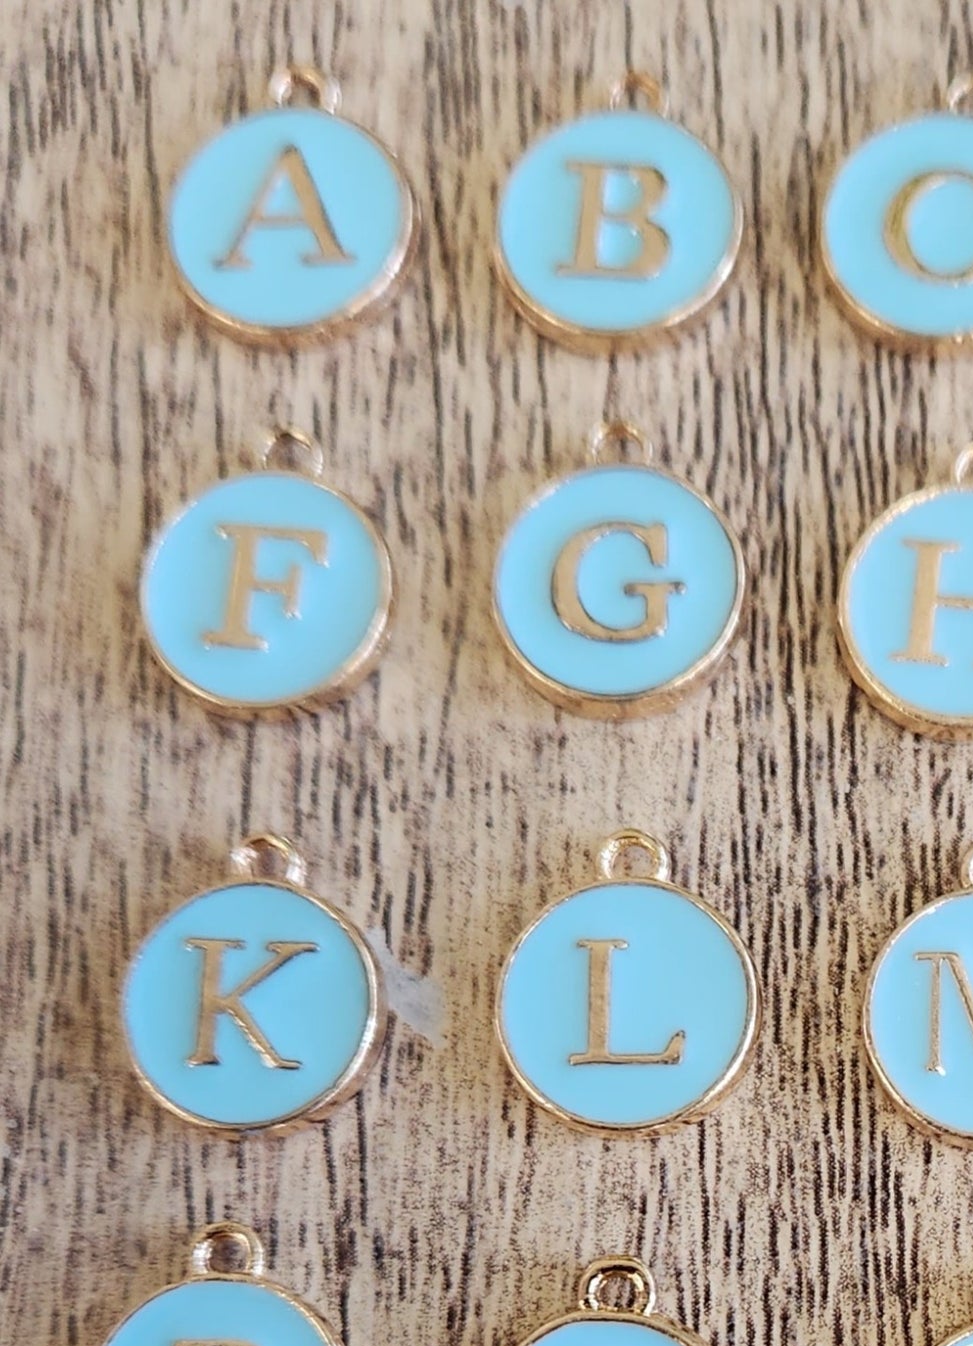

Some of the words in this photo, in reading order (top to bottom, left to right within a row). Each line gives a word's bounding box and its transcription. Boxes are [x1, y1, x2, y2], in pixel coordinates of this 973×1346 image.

[213, 144, 354, 271] A
[555, 163, 670, 280] B
[202, 524, 328, 649] F
[550, 521, 686, 640] G
[181, 937, 321, 1071] K
[570, 938, 687, 1066] L
